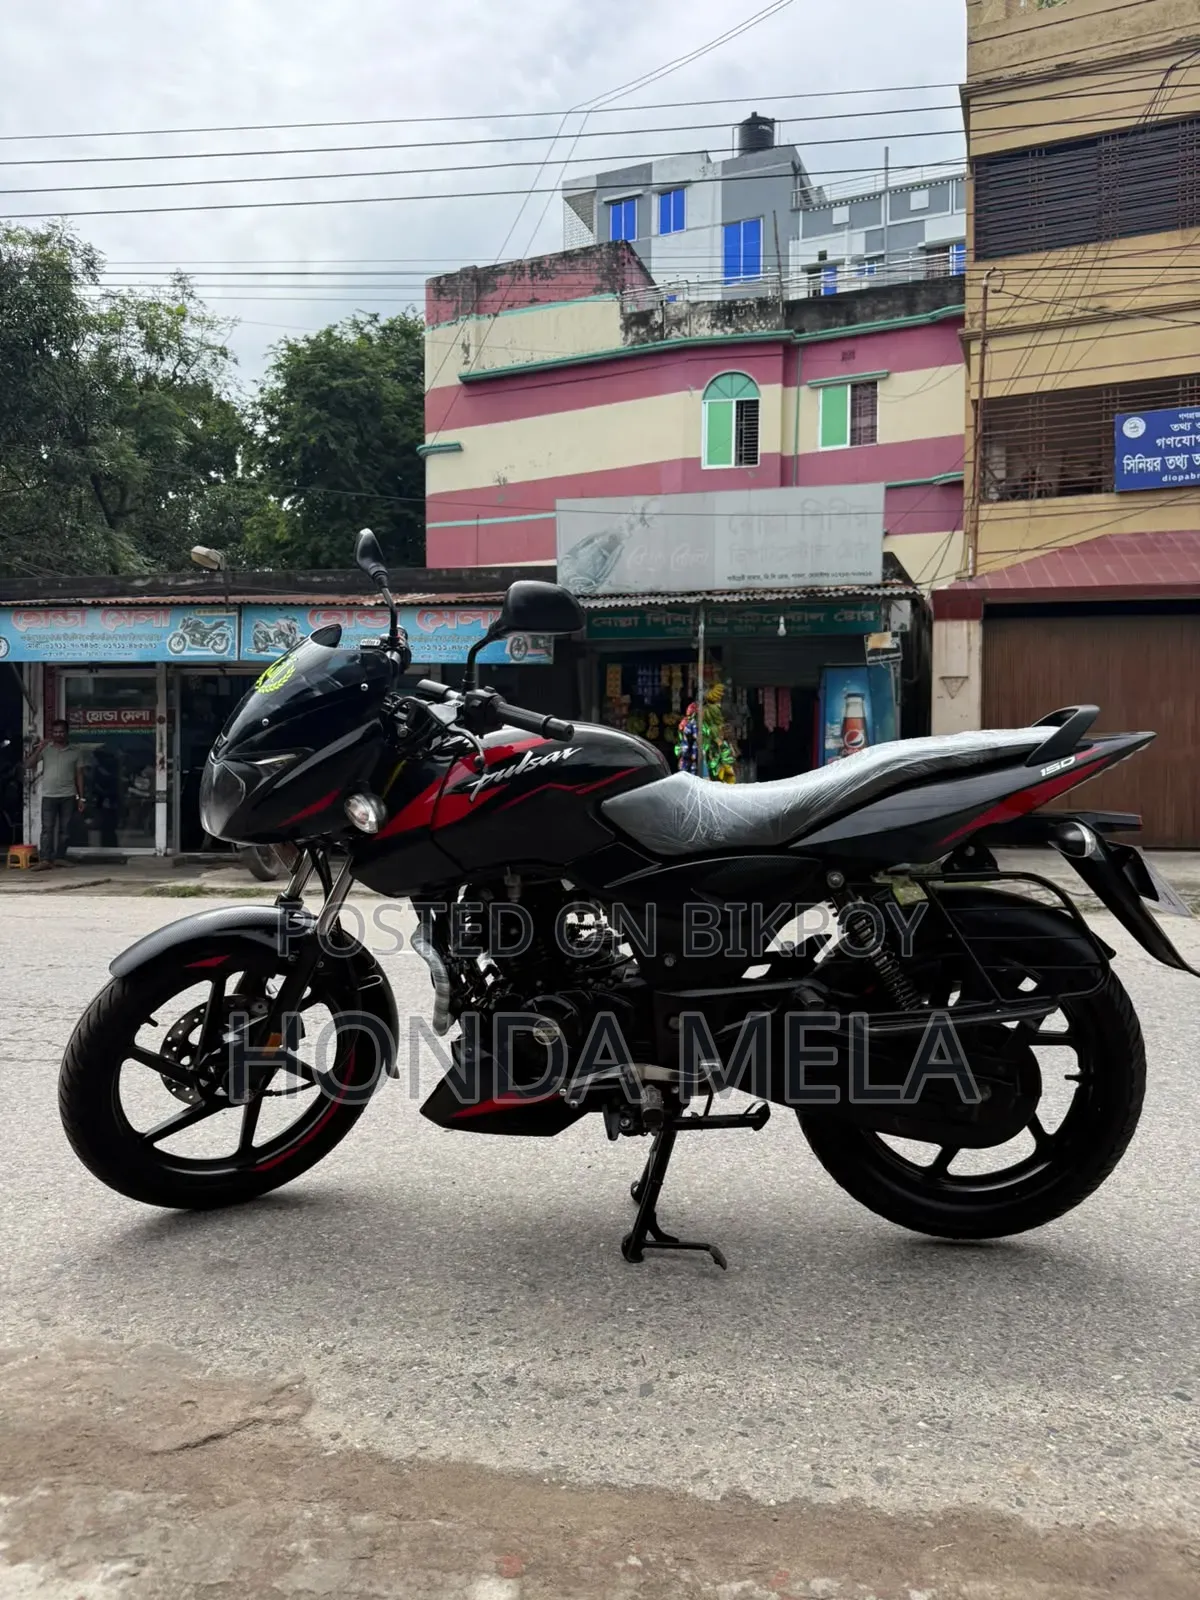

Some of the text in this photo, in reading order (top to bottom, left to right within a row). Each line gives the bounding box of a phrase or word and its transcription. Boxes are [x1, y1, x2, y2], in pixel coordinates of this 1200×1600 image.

[1169, 422, 1192, 432] তথ্য
[1122, 453, 1163, 475] সিনিয়র
[1164, 452, 1190, 470] তথ্য
[11, 608, 172, 633] হোন্ডা মেলা
[86, 710, 151, 723] হোন্ডা মেলা
[1040, 755, 1076, 777] 150
